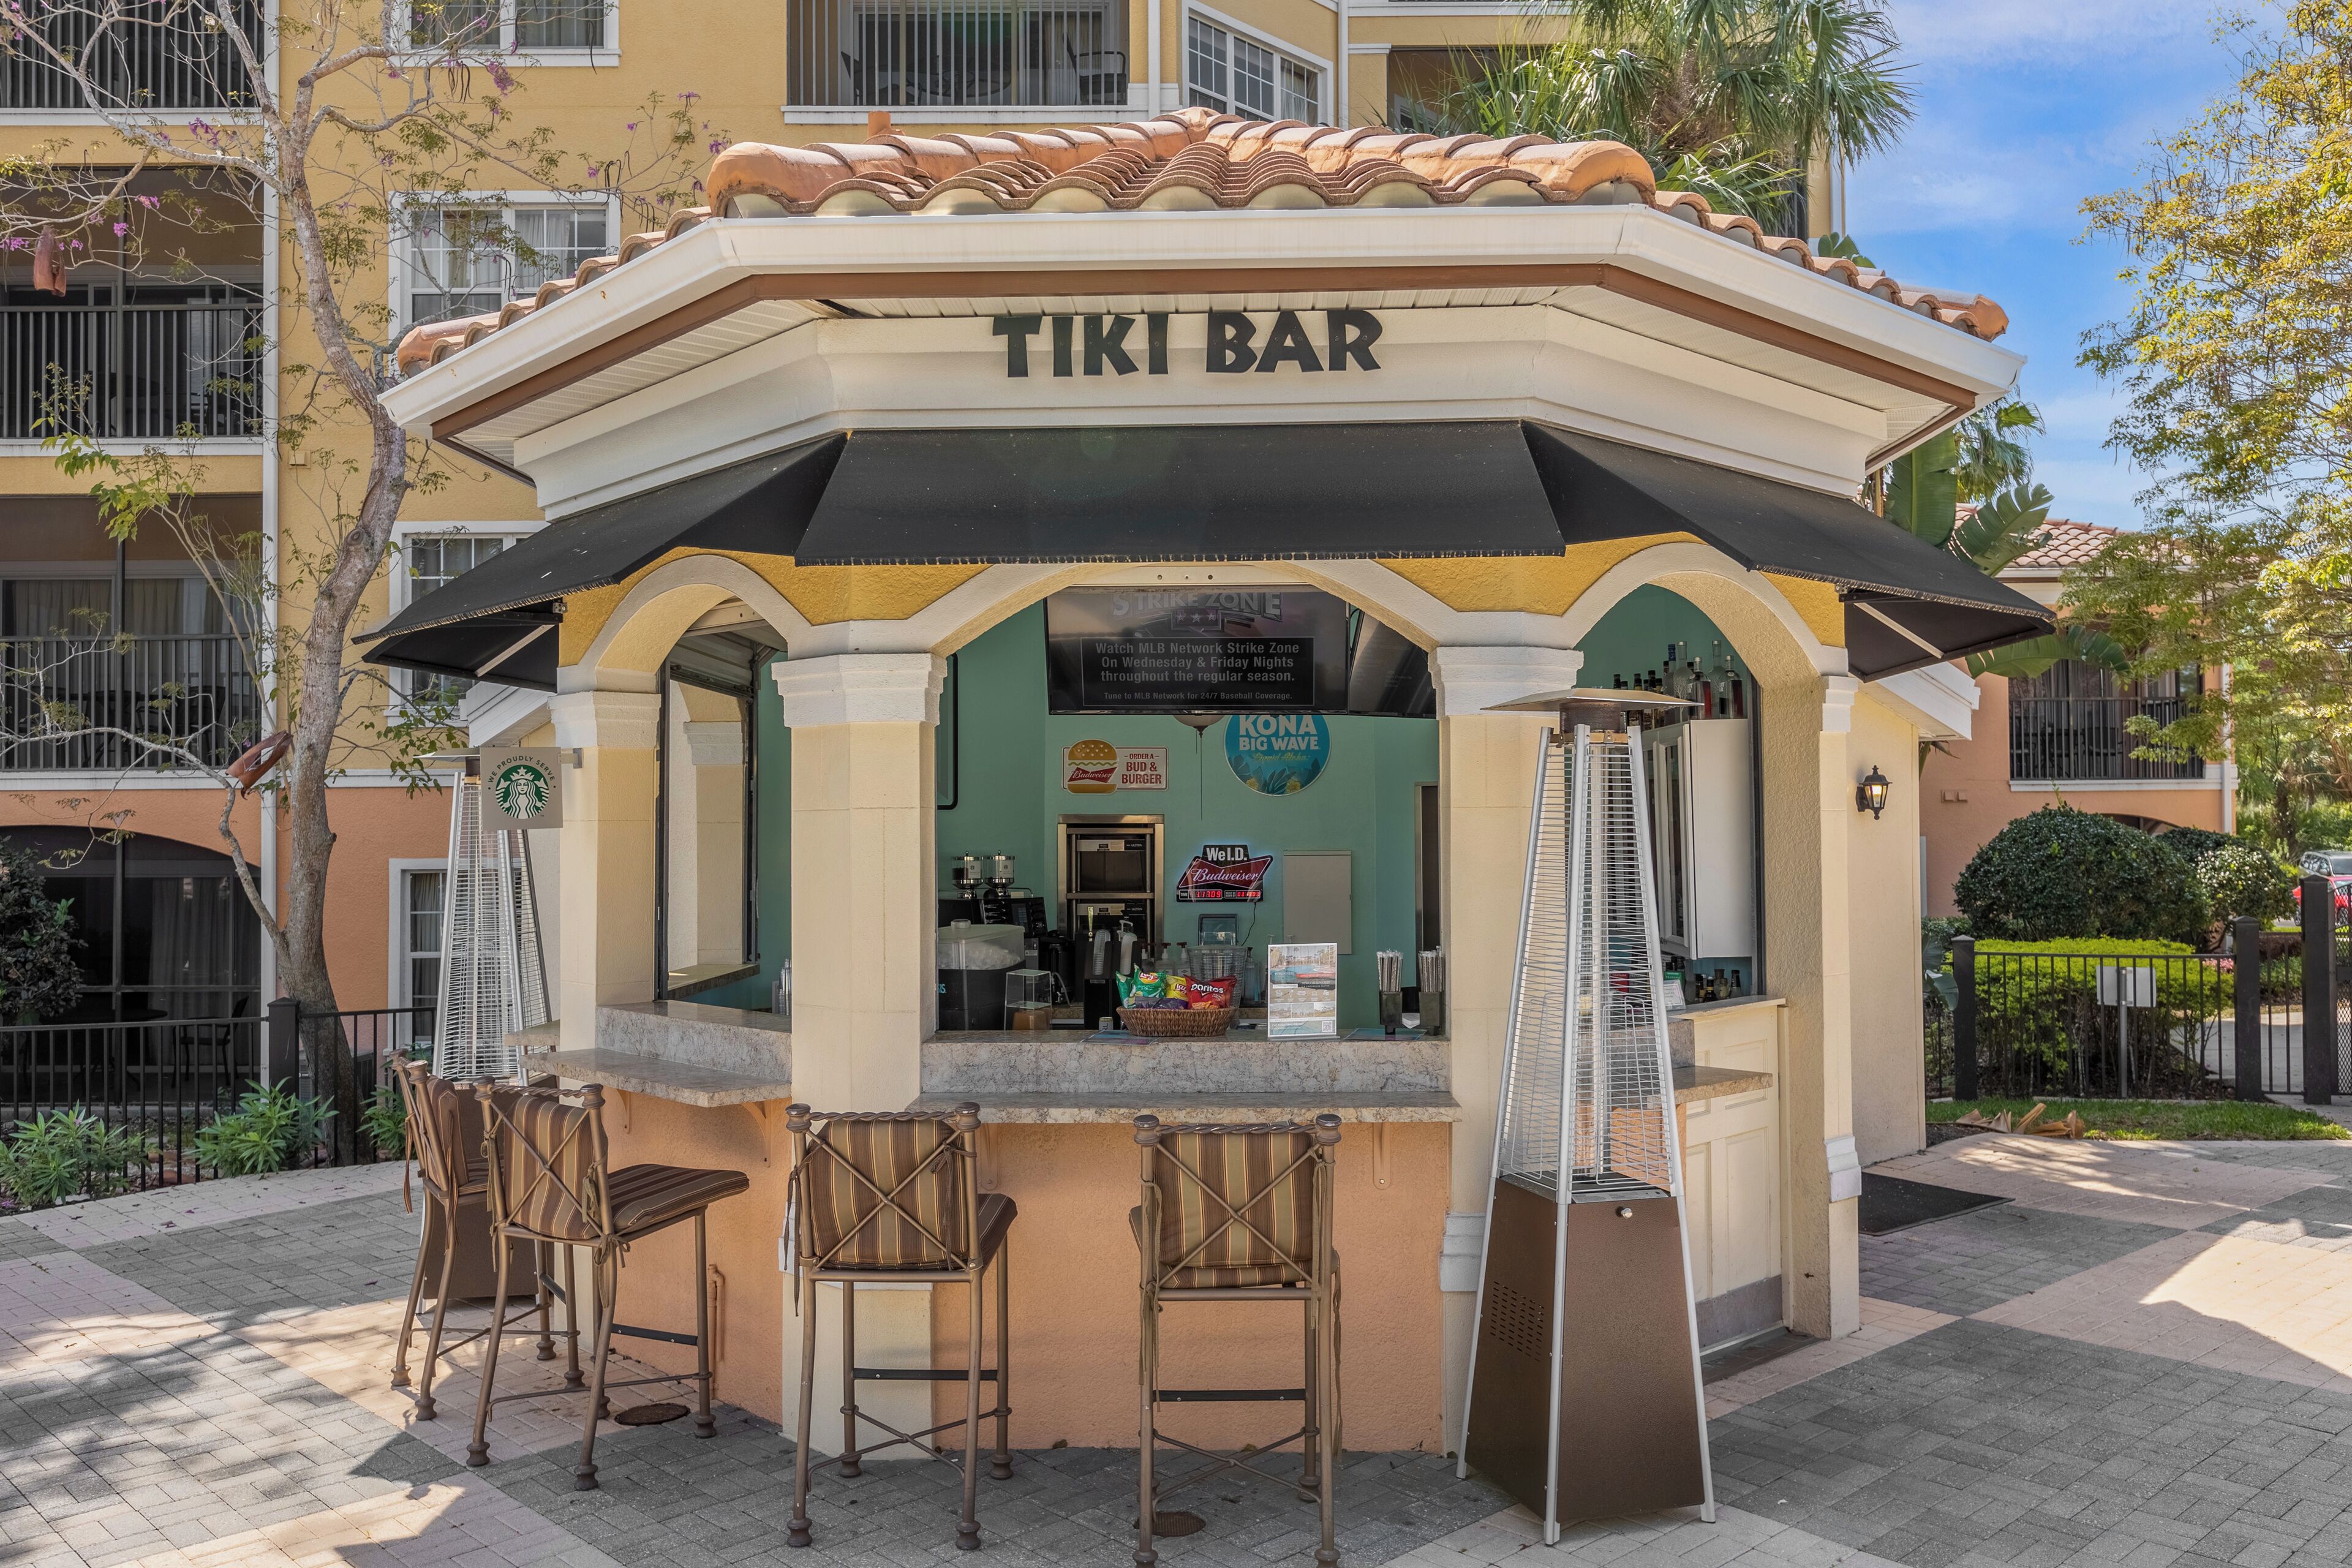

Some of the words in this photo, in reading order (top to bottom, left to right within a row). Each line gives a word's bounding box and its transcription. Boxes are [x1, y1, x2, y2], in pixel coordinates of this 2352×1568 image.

[992, 315, 1169, 377] TIKI
[1206, 310, 1383, 373] BAR
[1112, 592, 1199, 616] STRIKE
[1206, 592, 1281, 615] ZONE
[1095, 643, 1134, 654] Watch
[1139, 643, 1165, 654] MLB
[1170, 642, 1223, 654] Network
[1227, 642, 1264, 654] Strike
[1269, 643, 1299, 654] Zone
[1102, 657, 1118, 668] On
[1123, 656, 1192, 670] Wednesday
[1197, 657, 1206, 668] &
[1210, 656, 1248, 669] Friday
[1254, 656, 1294, 669] Nights
[1101, 670, 1170, 684] throughout
[1174, 671, 1194, 681] the
[1198, 671, 1243, 684] regular
[1248, 673, 1295, 681] season.
[1254, 692, 1292, 701] Coverage.
[1239, 715, 1317, 737] KONA
[1239, 737, 1267, 750] BIG
[1270, 736, 1319, 750] WAVE
[488, 771, 497, 783] WE
[497, 756, 533, 769] PROUDLY
[536, 760, 555, 781] SERVE
[1126, 762, 1147, 772] BUD
[1149, 762, 1158, 772] &
[1071, 770, 1112, 779] Budweiser
[1121, 774, 1162, 784] BURGER
[1206, 847, 1226, 861] We
[1227, 847, 1247, 861] I.D.
[1191, 868, 1259, 881] Budweiser
[1191, 984, 1224, 993] Doritos
